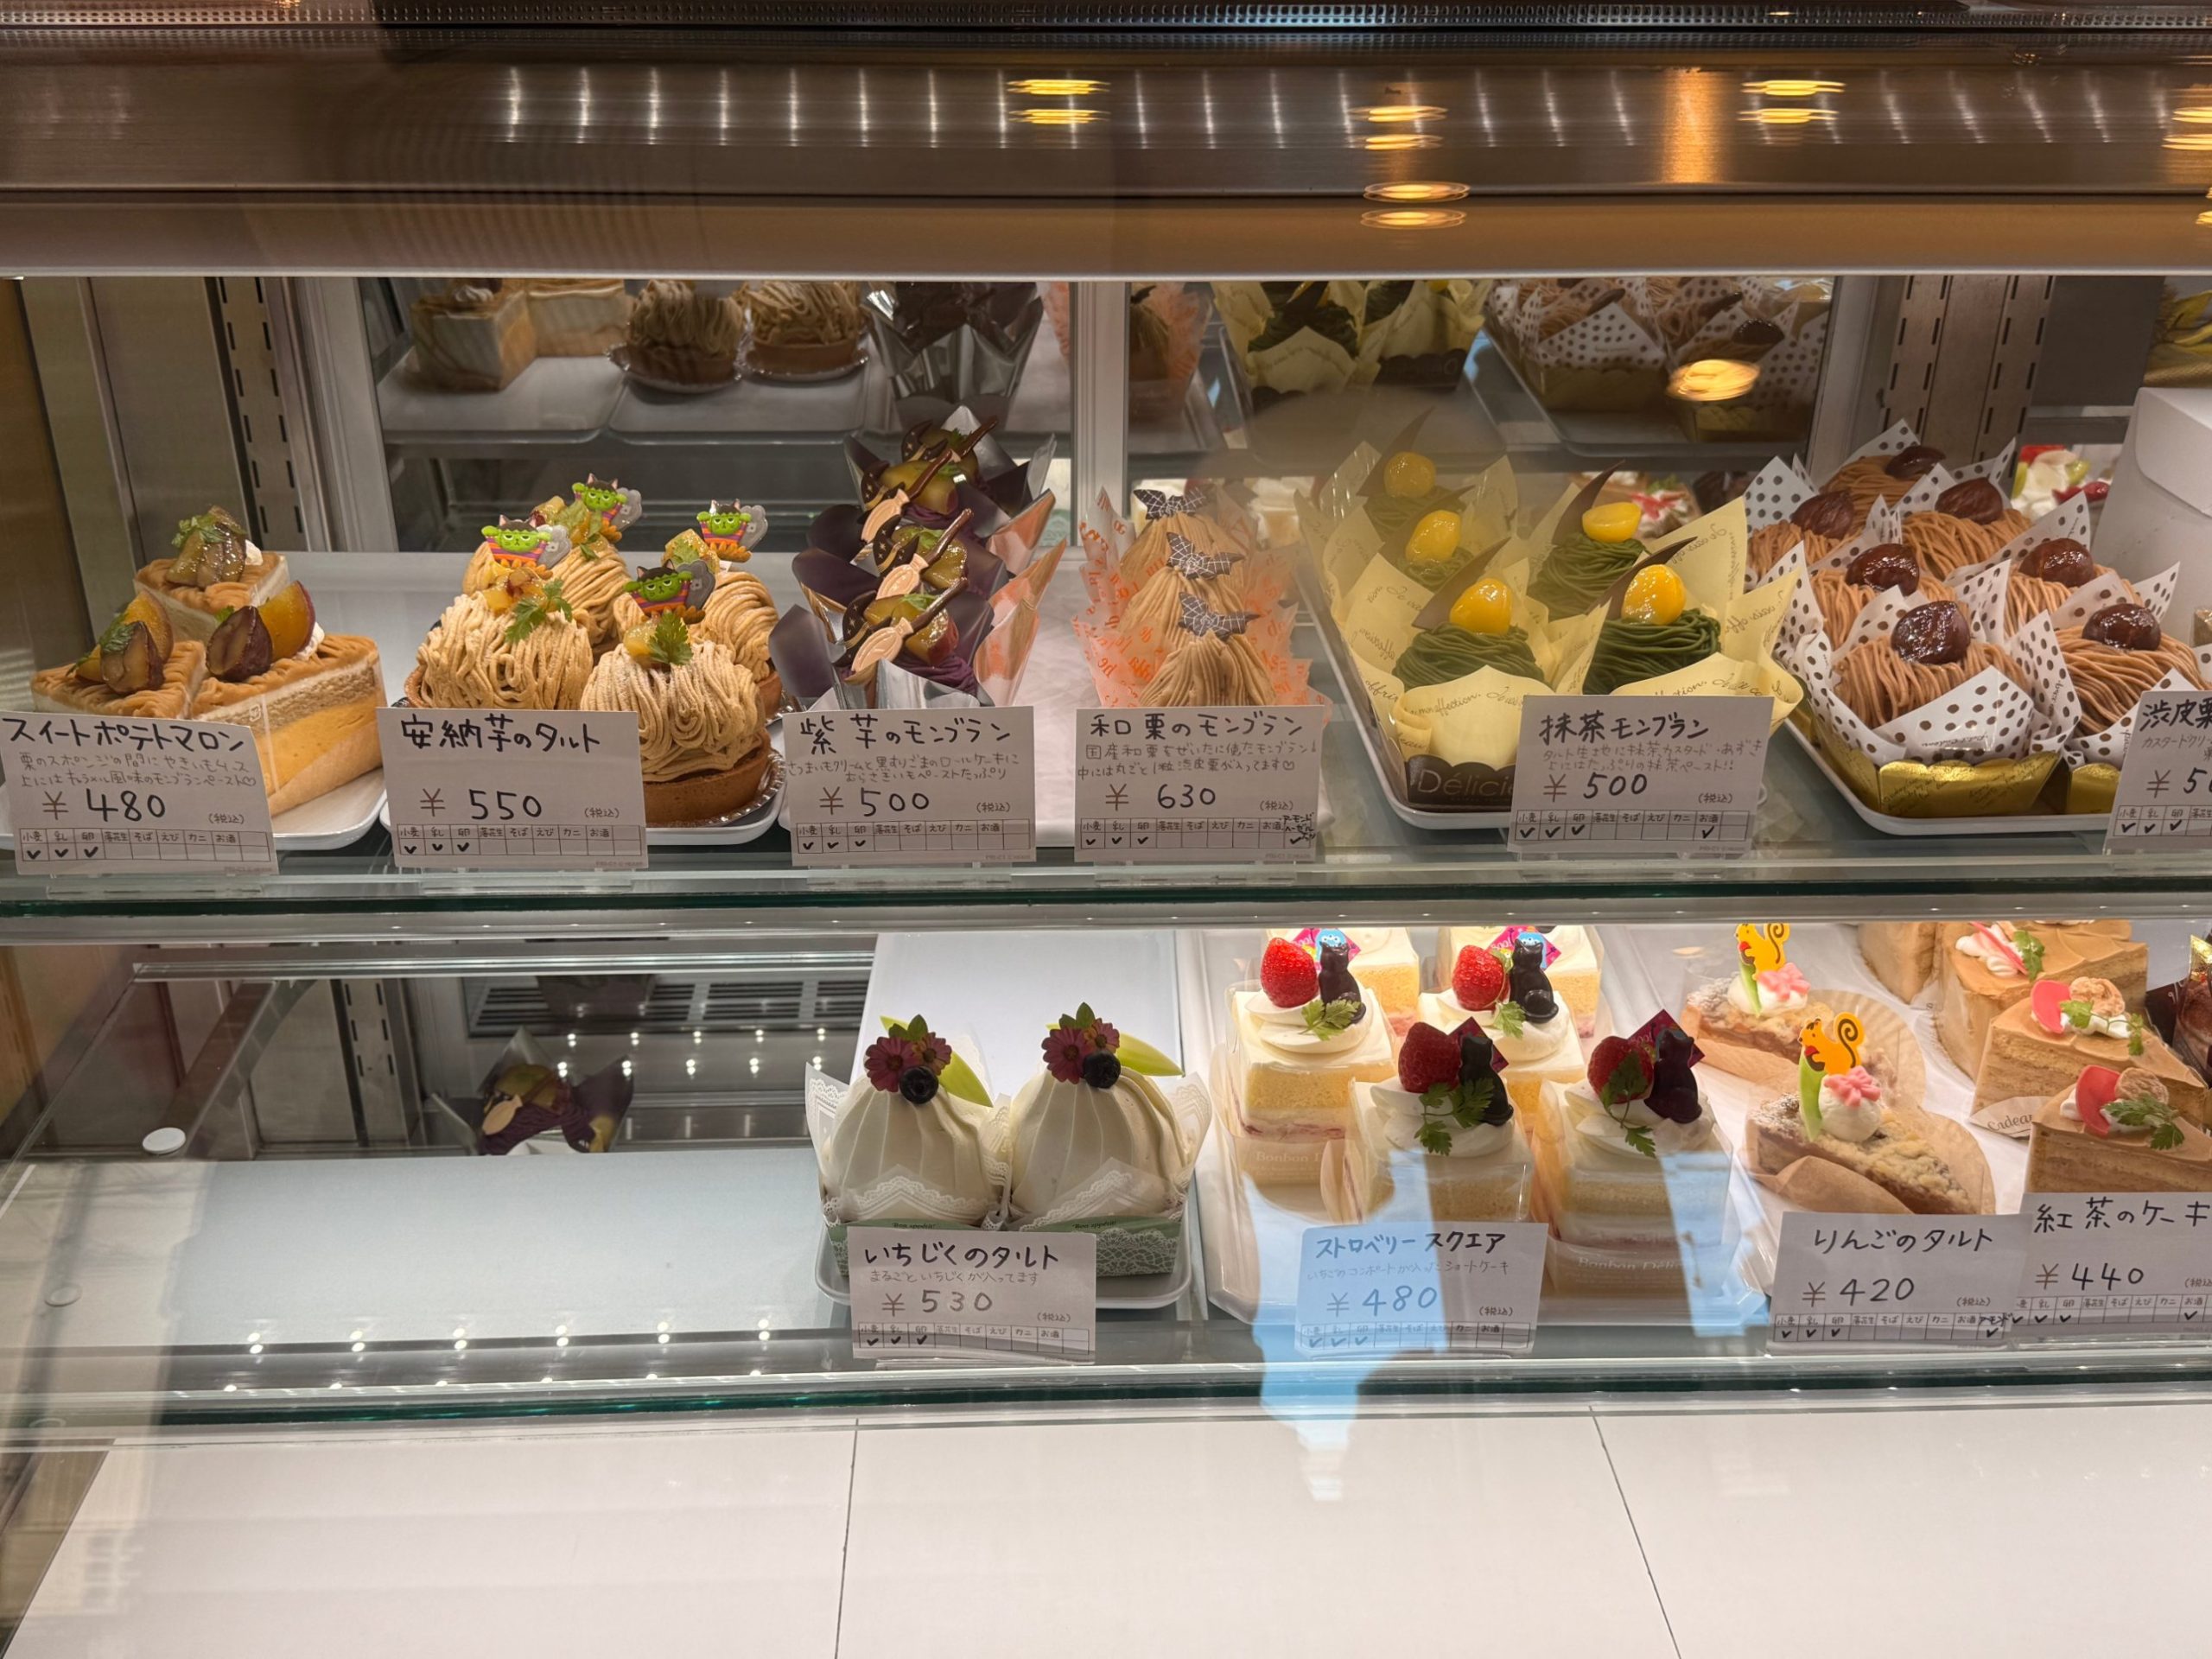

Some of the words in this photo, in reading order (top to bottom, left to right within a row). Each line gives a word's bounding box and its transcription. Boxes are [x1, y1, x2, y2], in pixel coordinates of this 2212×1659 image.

[2, 718, 244, 752] スイートポテトマロン
[401, 713, 601, 753] 安納芋のタルト
[800, 713, 1010, 754] 紫芋のモンブラン
[1090, 711, 1302, 740] 和栗のモンブラン
[1539, 709, 1709, 746] 抹茶モンブラン
[861, 787, 929, 817] 500
[976, 803, 1011, 812] (税込)
[1158, 784, 1216, 809] 630
[1260, 800, 1294, 810] (税込)
[1584, 772, 1648, 799] 500
[1698, 792, 1732, 804] (税込)
[86, 788, 166, 822] 480
[208, 813, 245, 824] (税込)
[468, 789, 542, 821] 550
[584, 808, 620, 818] (税込)
[2034, 1196, 2210, 1233] 紅茶のケーキ
[864, 1241, 1058, 1270] いちじくのタルト
[1315, 1234, 1416, 1259] ストロベリー
[1425, 1231, 1506, 1254] スクエア
[1815, 1228, 1993, 1254] りんごのタルト
[1840, 1277, 1914, 1306] 420
[1956, 1297, 1991, 1307] (税込)
[2072, 1262, 2144, 1291] 440
[921, 1289, 993, 1313] 530
[1037, 1313, 1071, 1322] (税込)
[1362, 1285, 1438, 1316] 480
[1479, 1306, 1513, 1317] (税込)
